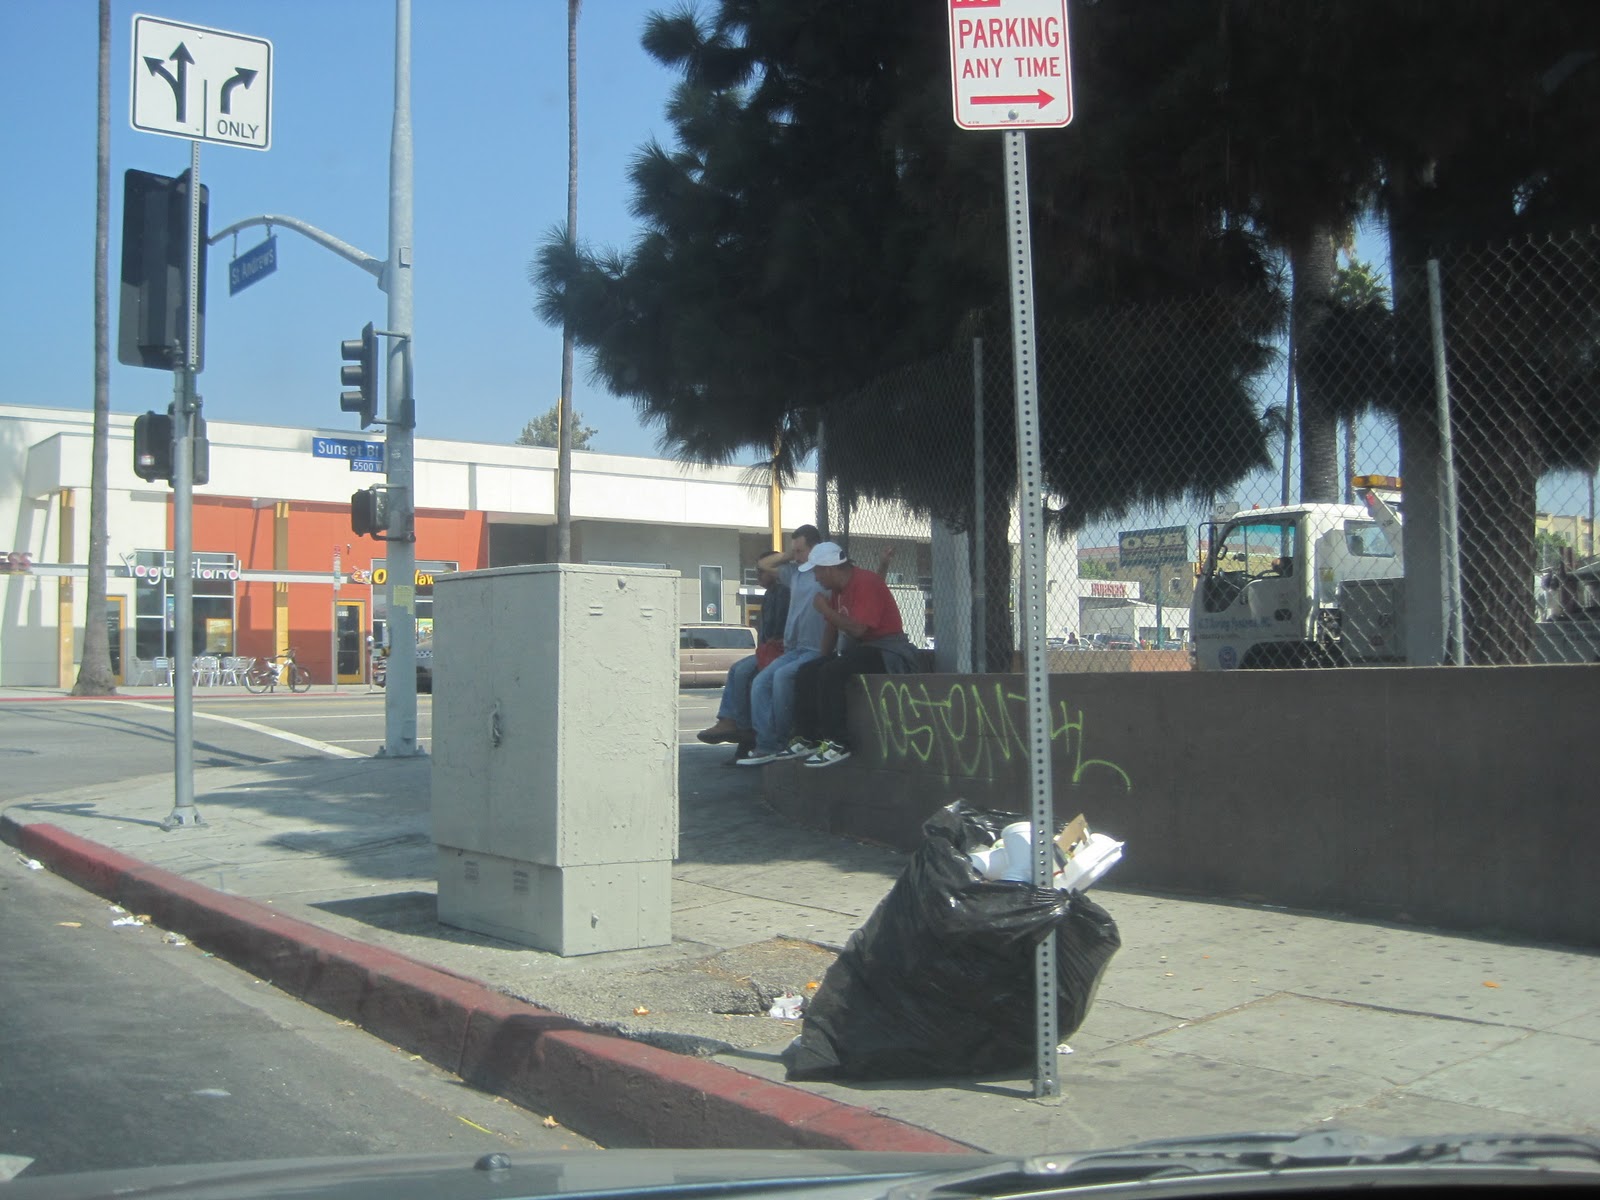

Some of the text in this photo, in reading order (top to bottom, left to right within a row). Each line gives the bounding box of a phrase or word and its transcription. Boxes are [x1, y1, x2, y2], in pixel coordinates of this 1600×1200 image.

[958, 17, 1060, 49] PARKING
[962, 57, 1061, 79] ANY TIME
[216, 119, 259, 140] ONLY
[318, 440, 379, 458] Sunset Bl
[353, 461, 382, 472] 5500 W
[119, 552, 243, 585] Yoguland
